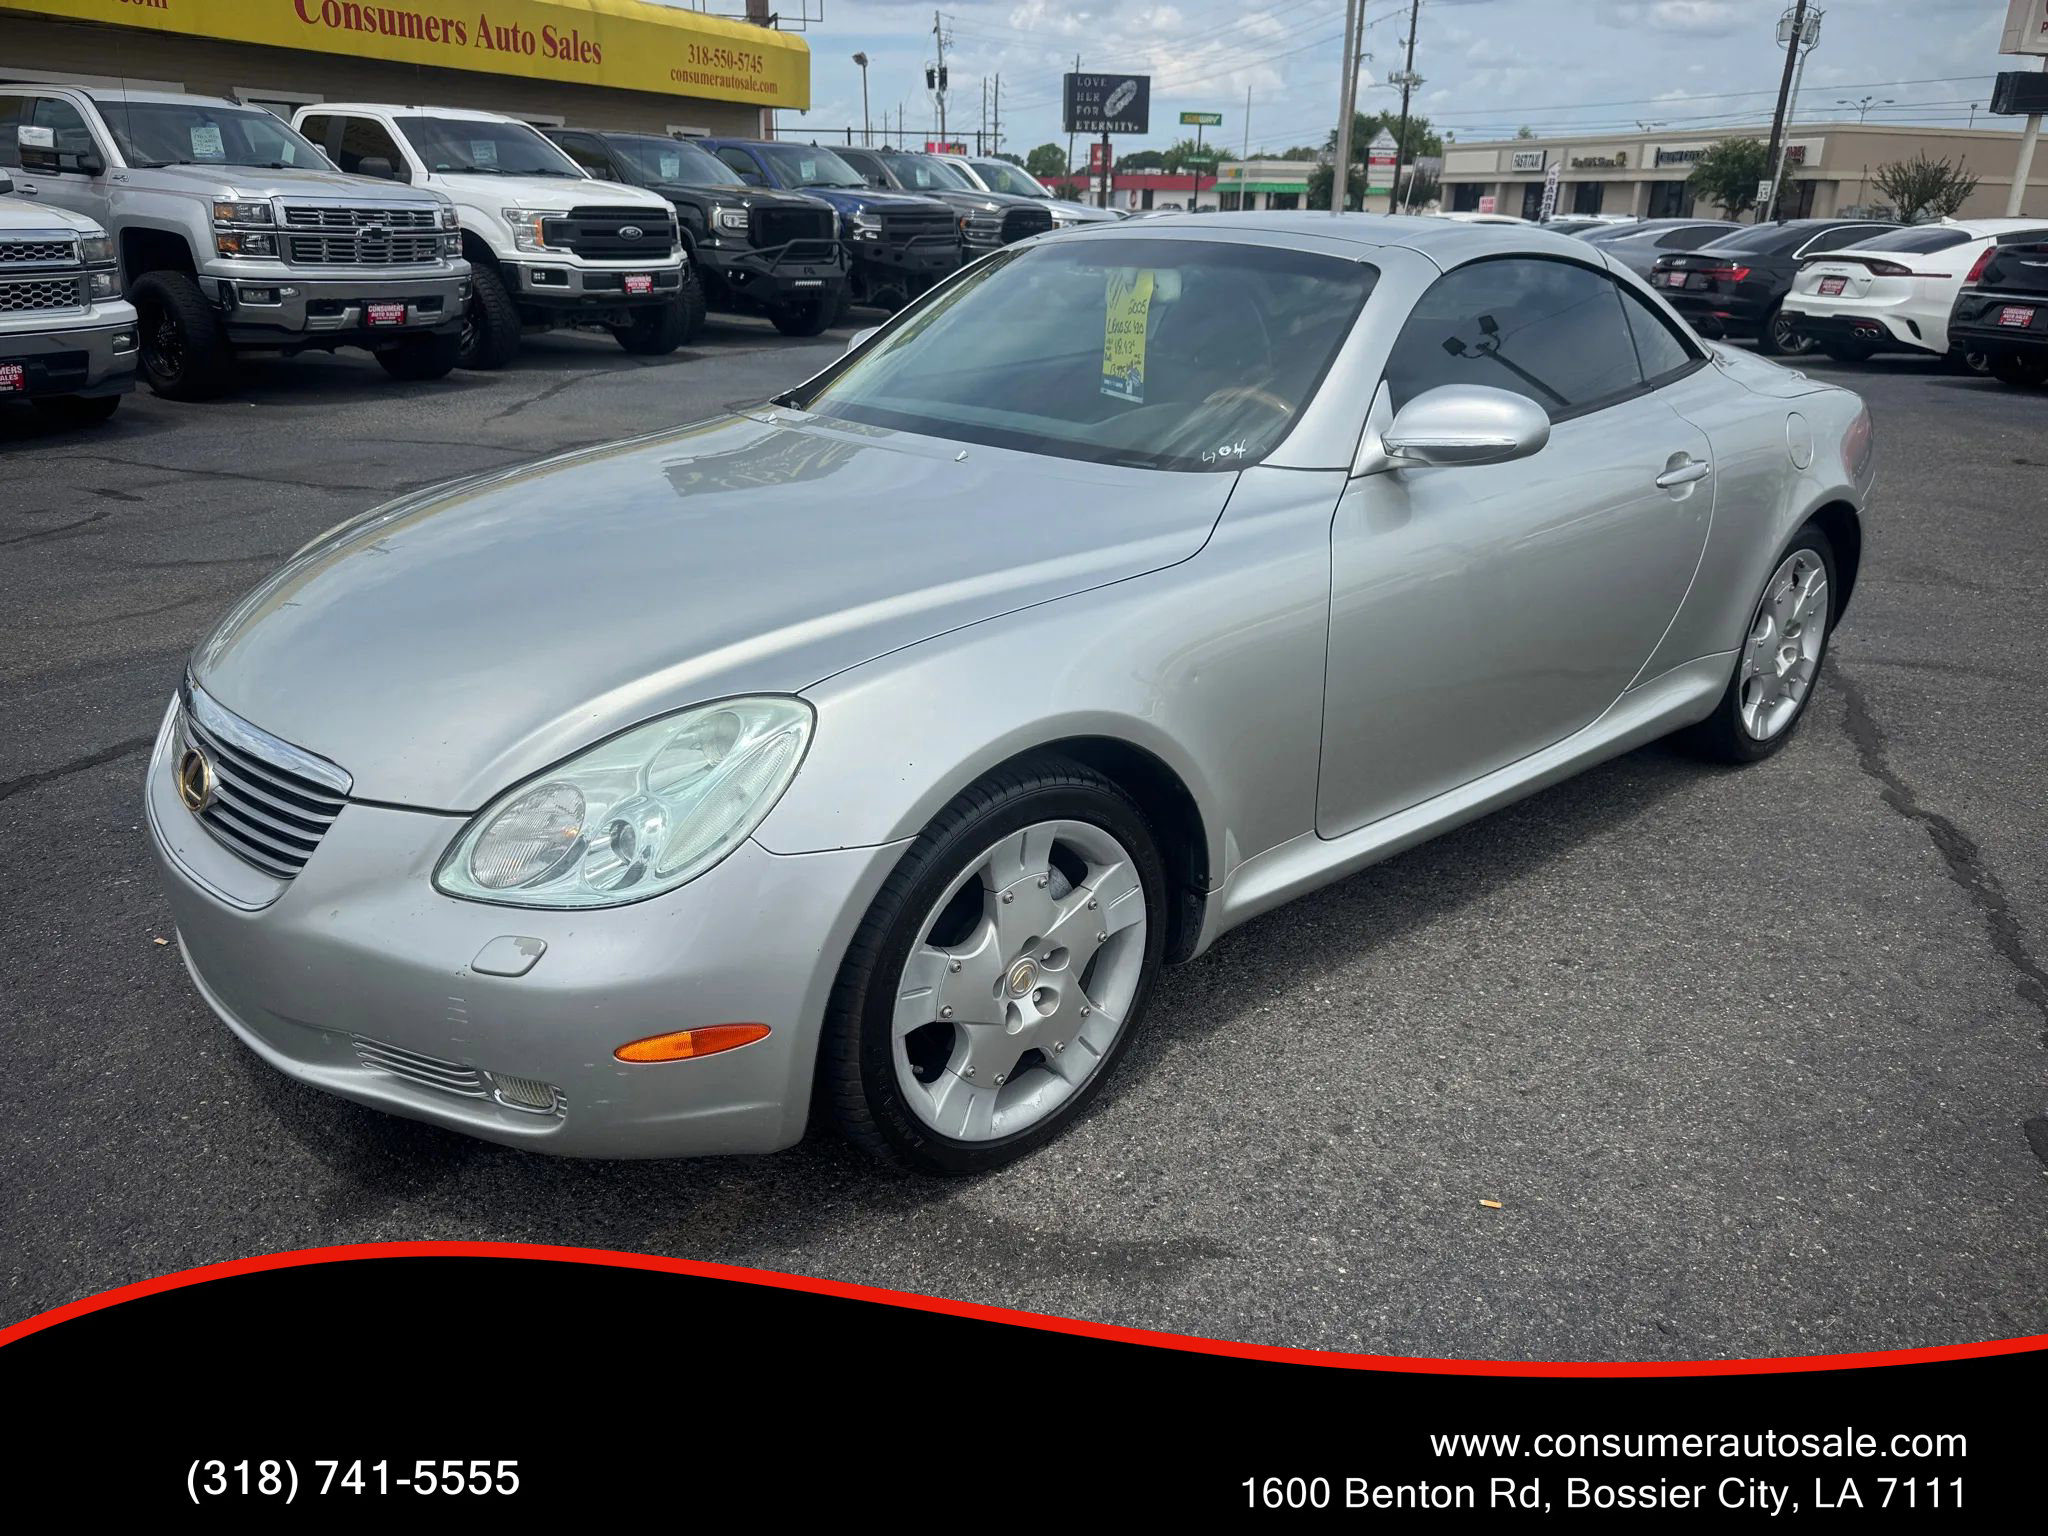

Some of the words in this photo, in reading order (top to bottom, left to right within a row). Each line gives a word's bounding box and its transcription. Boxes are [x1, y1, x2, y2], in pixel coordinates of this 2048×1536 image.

[294, 0, 468, 46] Consumers
[474, 13, 536, 55] Auto
[542, 24, 602, 65] Sales
[687, 43, 763, 74] 318-550-5745
[670, 68, 778, 94] consumerautosale.com
[1077, 77, 1107, 87] LOVE
[1076, 92, 1100, 102] HER
[1076, 105, 1099, 116] FOR
[1184, 114, 1220, 125] SUBWAY
[368, 303, 404, 313] CONSUMERS
